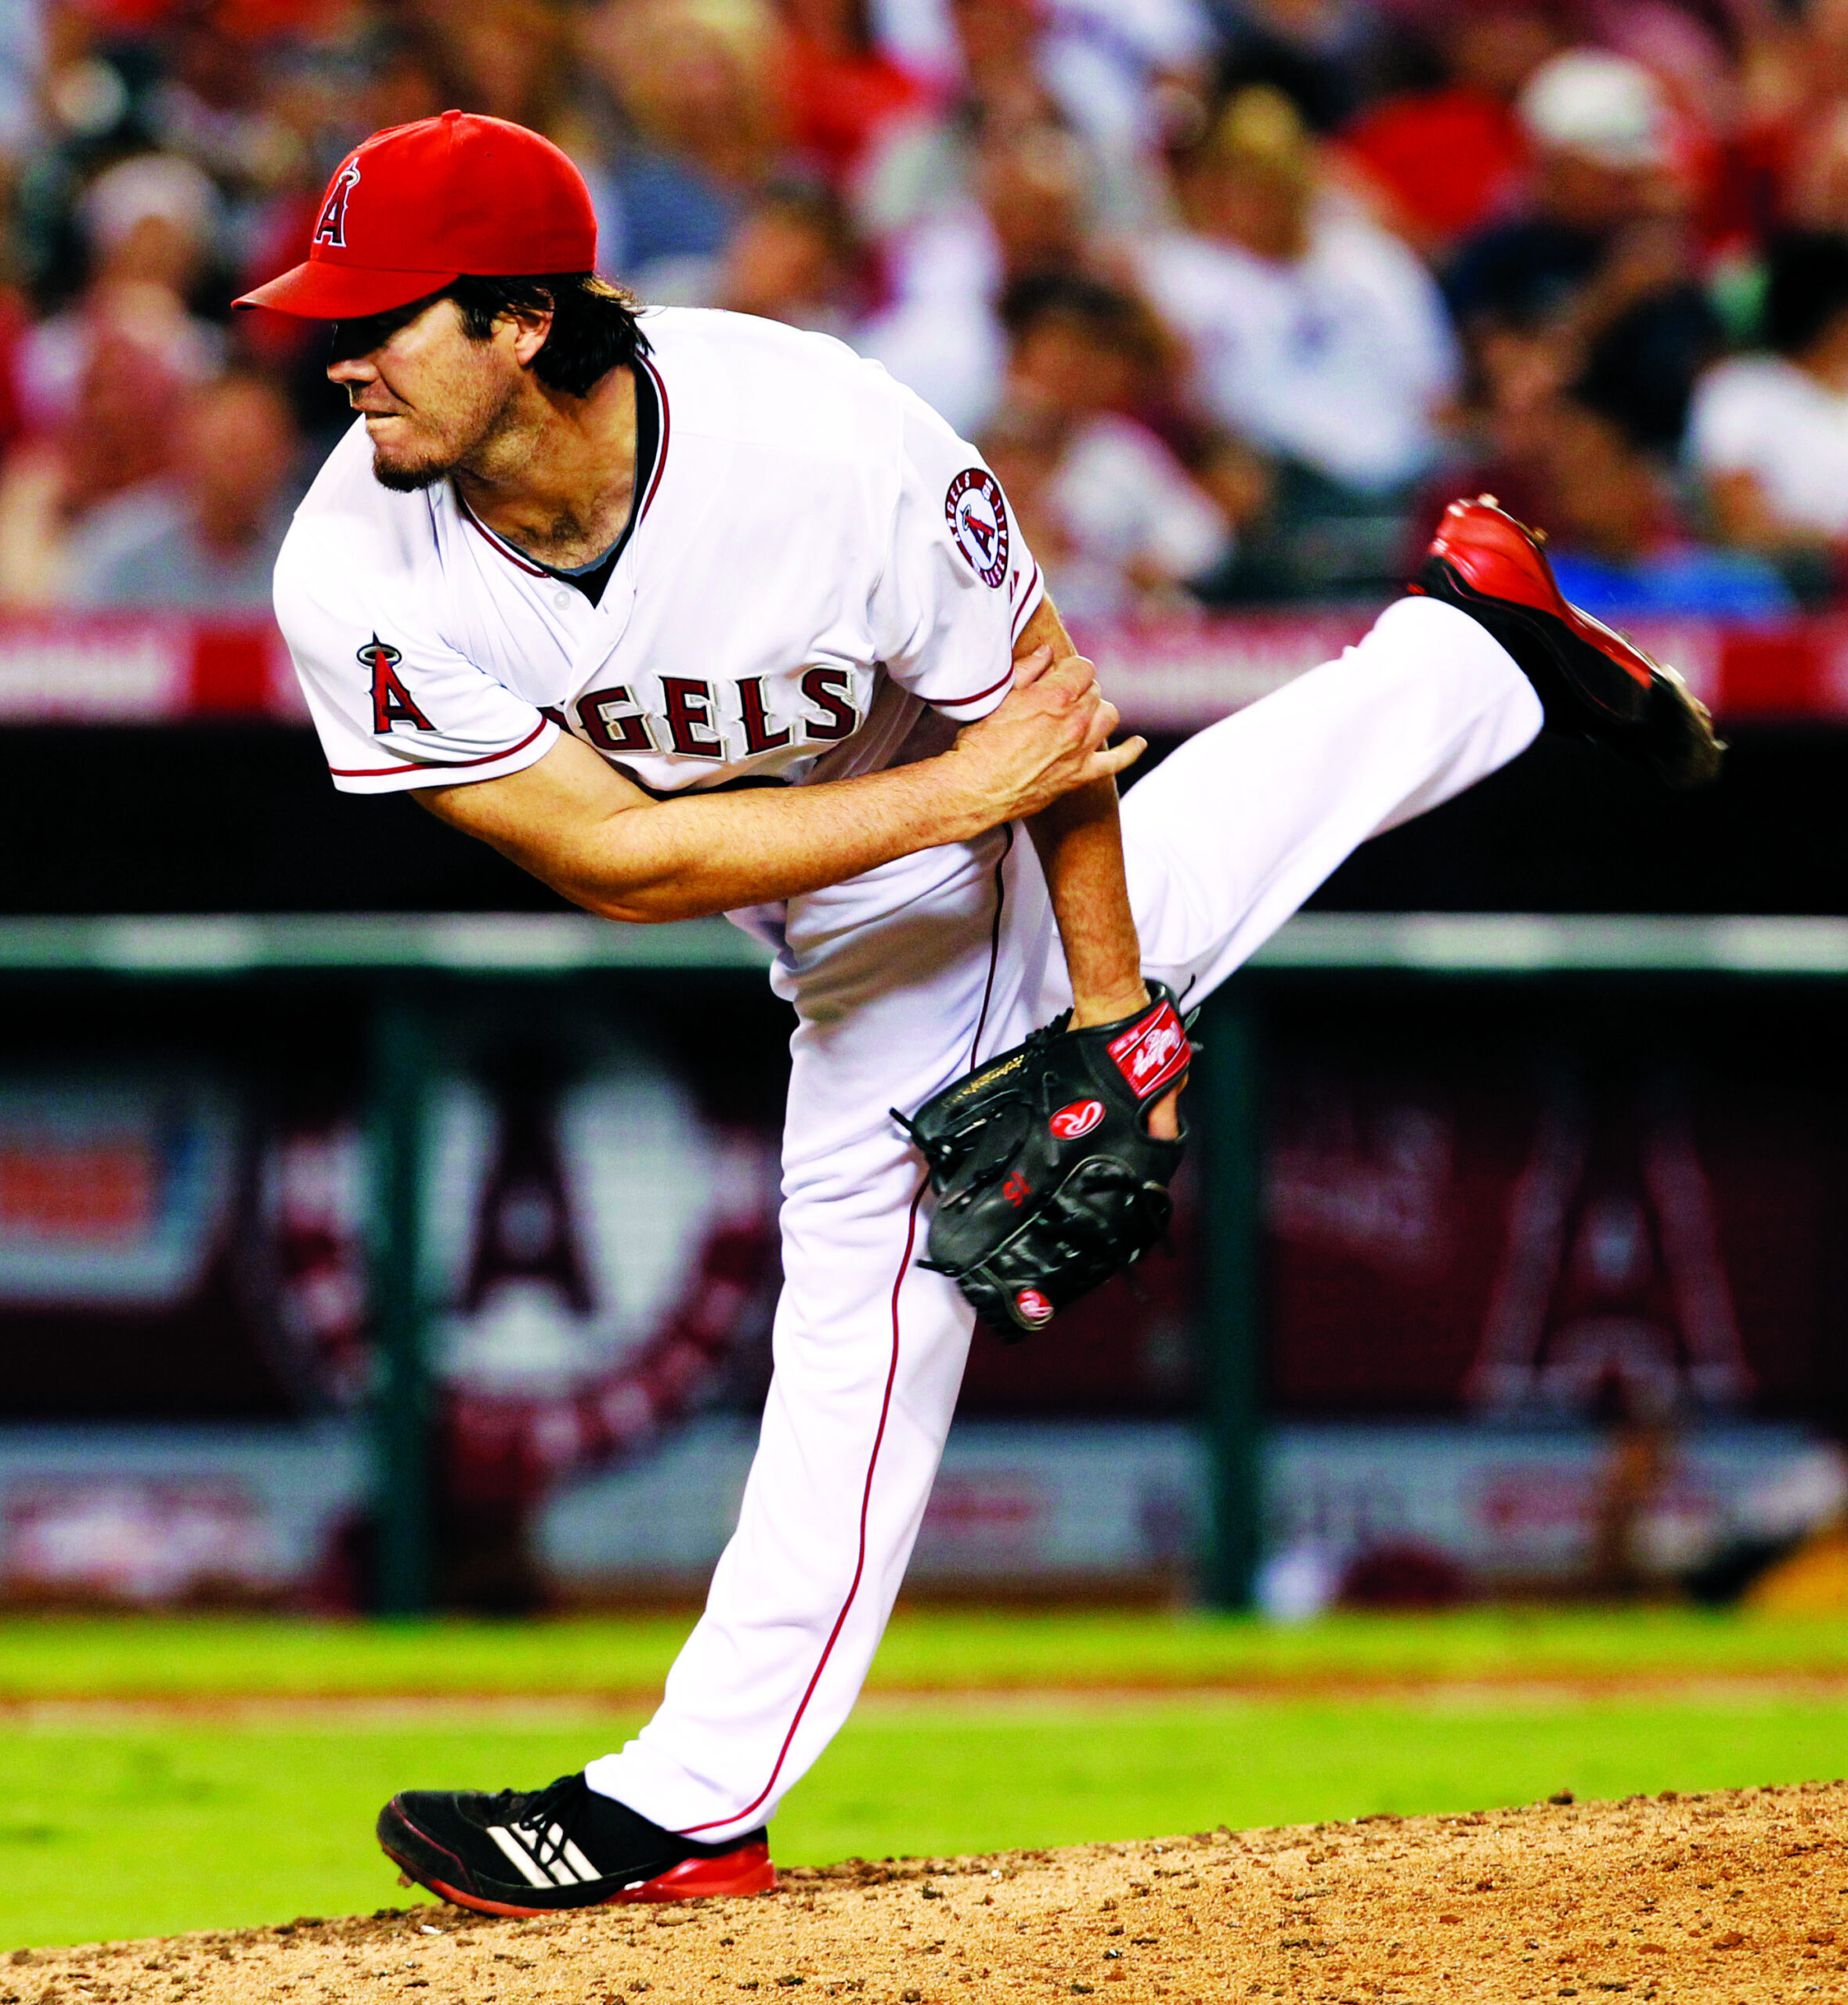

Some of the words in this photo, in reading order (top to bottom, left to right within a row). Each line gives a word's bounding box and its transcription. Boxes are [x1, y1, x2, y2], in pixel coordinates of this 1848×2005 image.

[313, 157, 361, 247] A
[946, 471, 971, 542] ANGELS
[356, 630, 438, 735] A
[536, 664, 861, 763] GELS
